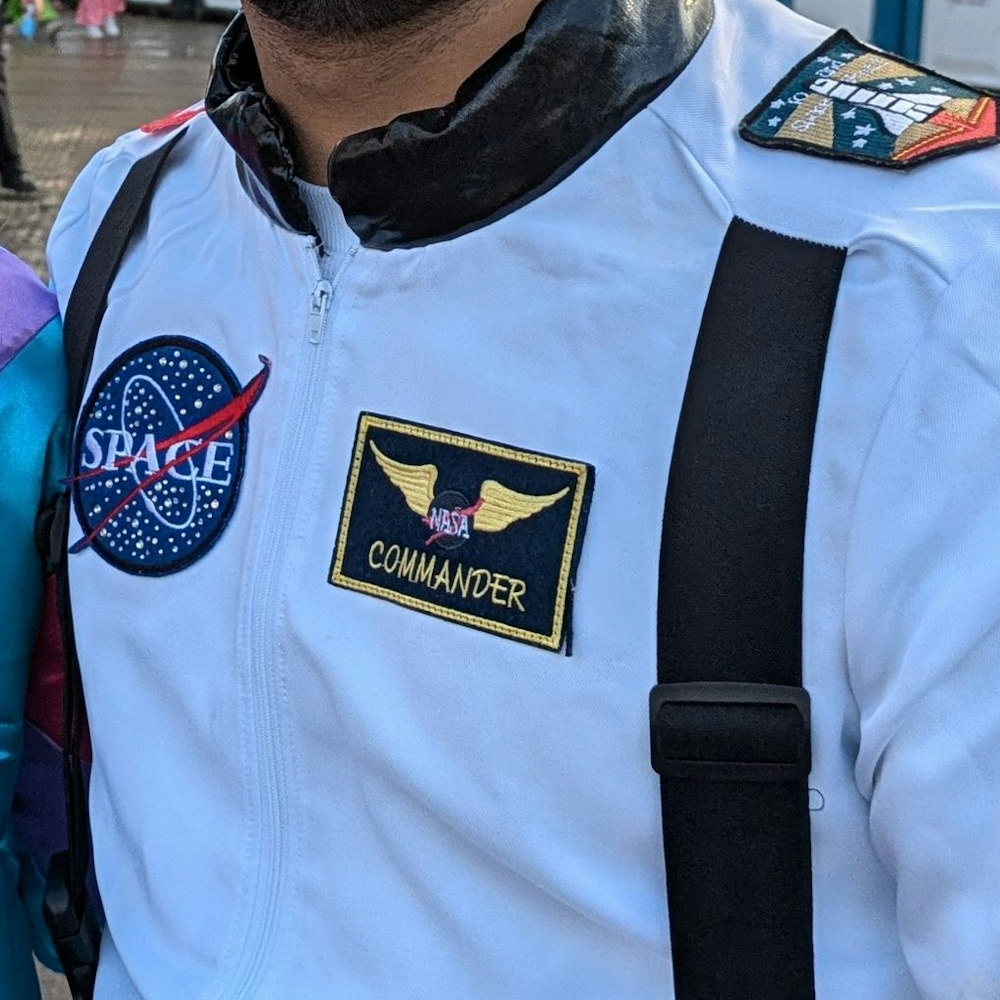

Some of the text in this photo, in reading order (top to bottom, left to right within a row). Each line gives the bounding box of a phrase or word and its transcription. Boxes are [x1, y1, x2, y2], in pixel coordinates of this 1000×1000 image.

[81, 427, 234, 486] SPACE
[429, 506, 470, 539] NASA
[368, 540, 527, 612] COMMANDER
